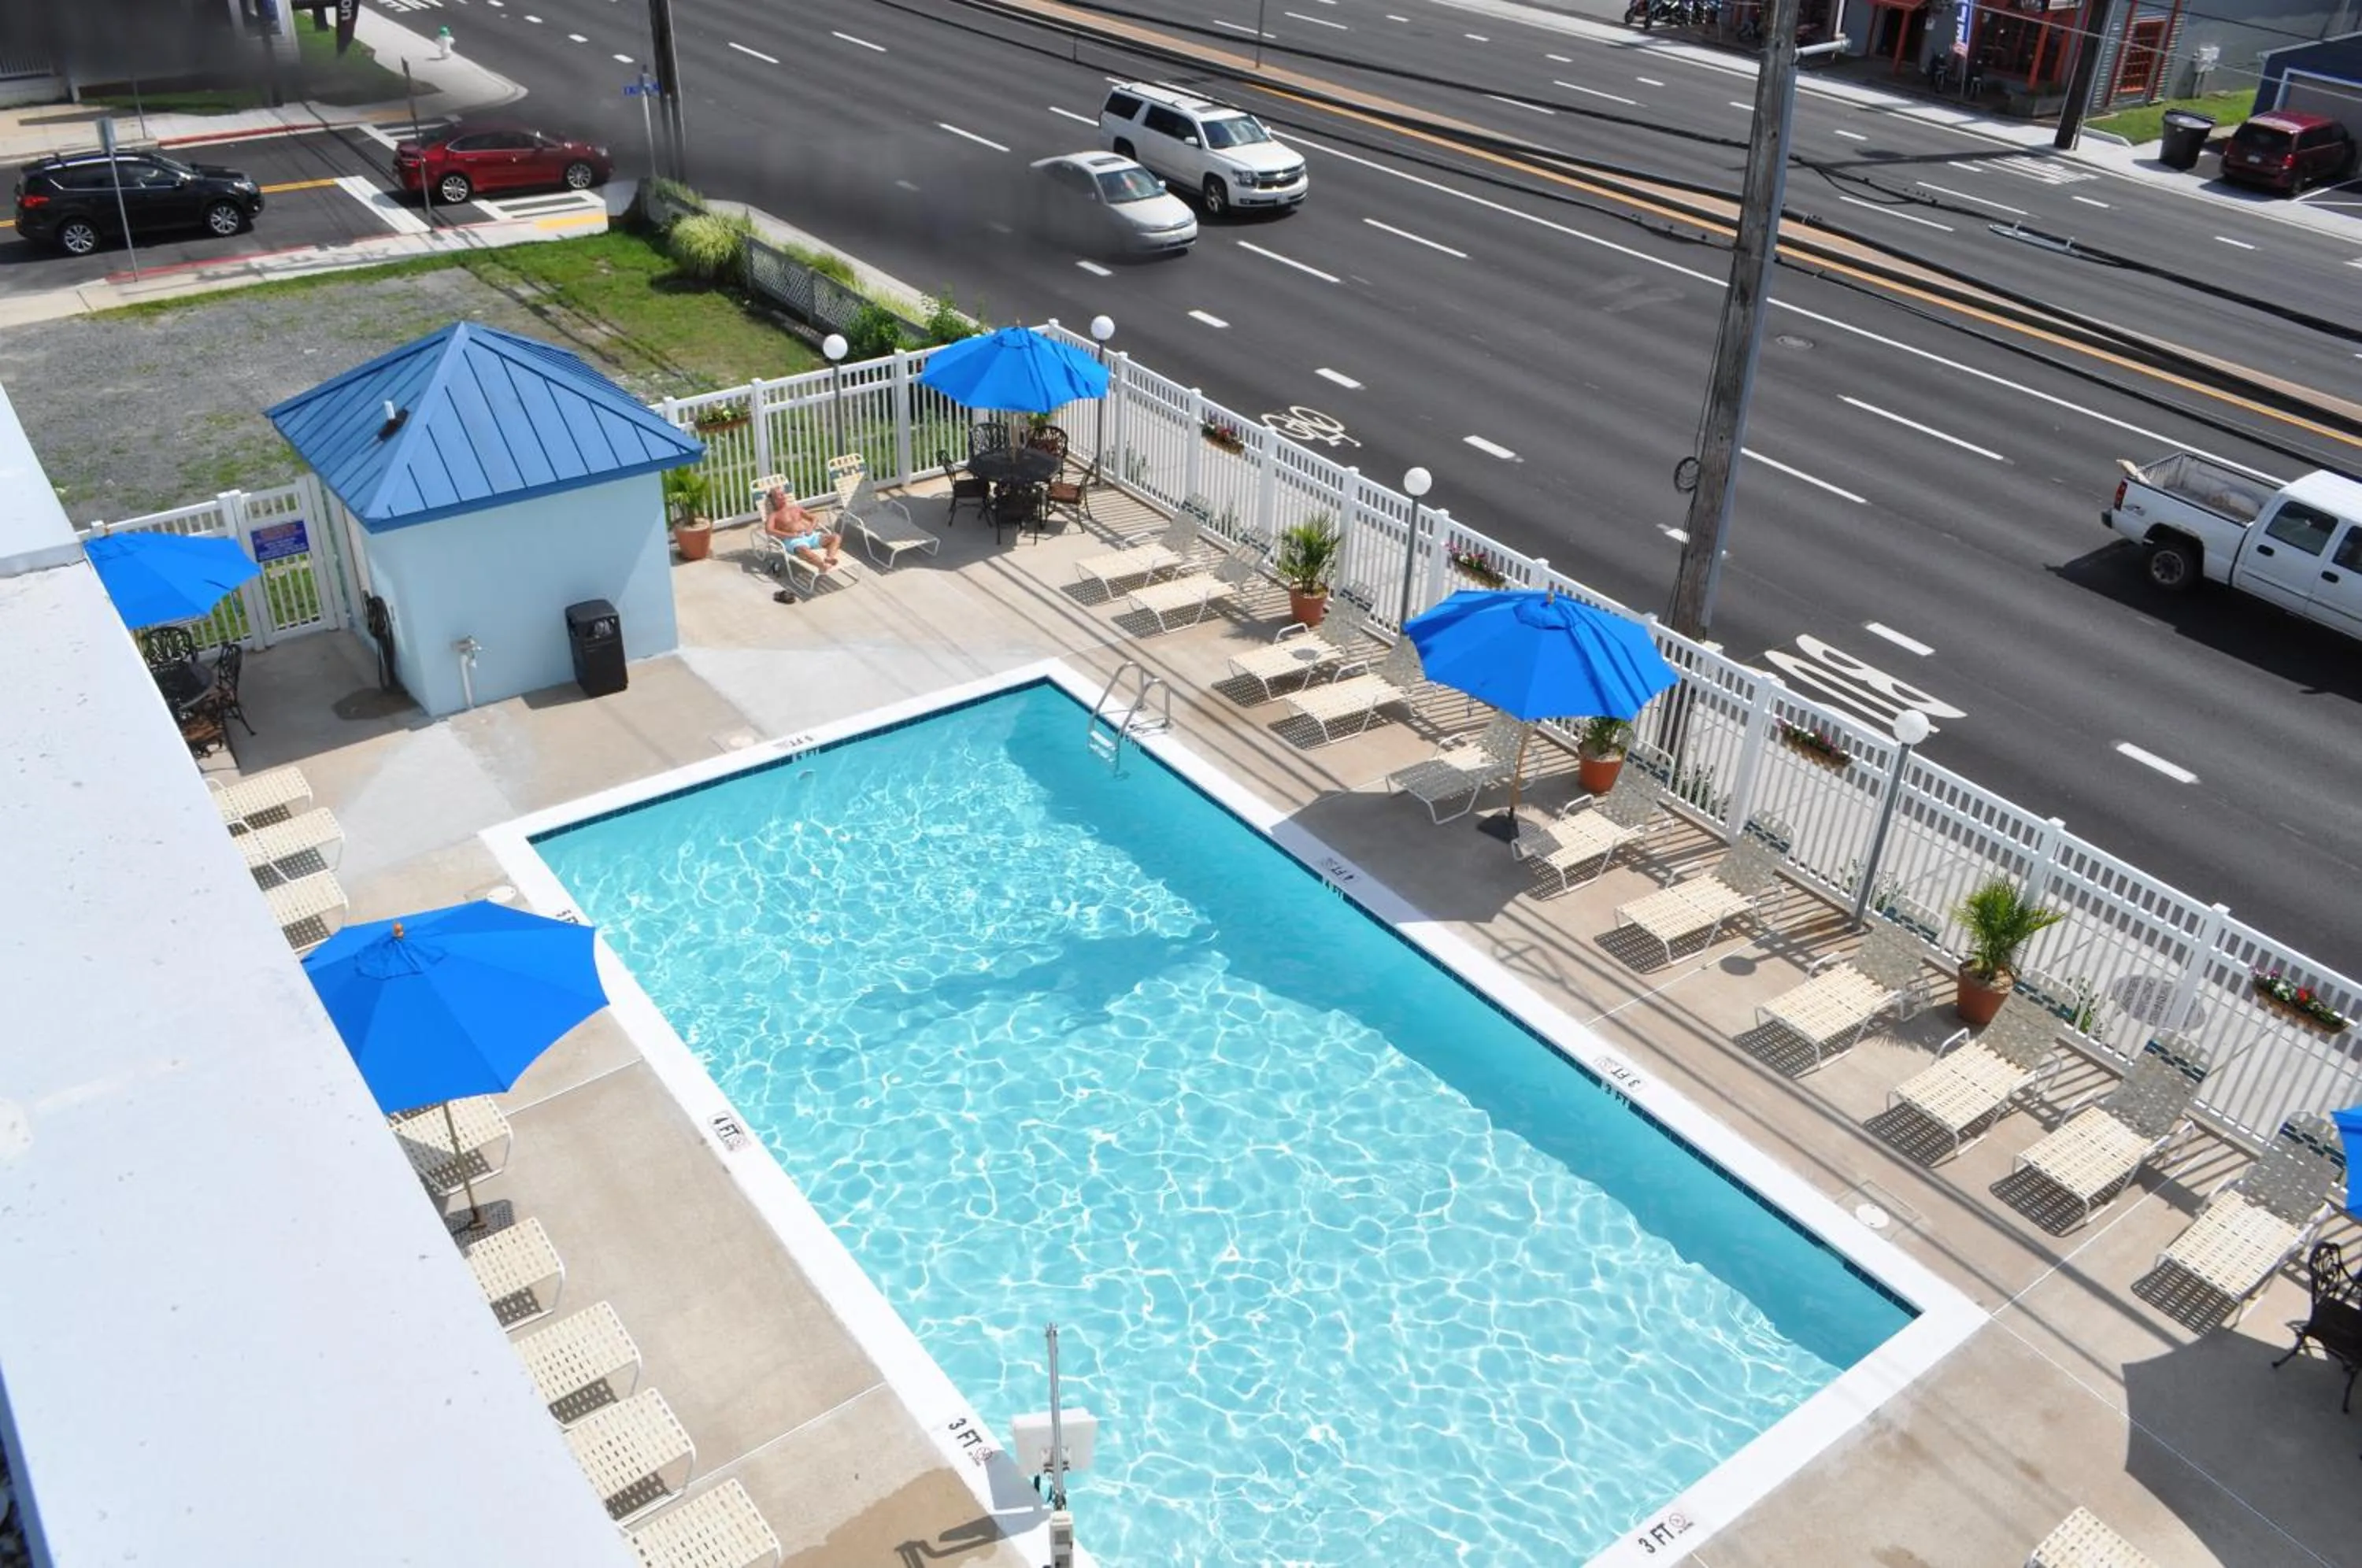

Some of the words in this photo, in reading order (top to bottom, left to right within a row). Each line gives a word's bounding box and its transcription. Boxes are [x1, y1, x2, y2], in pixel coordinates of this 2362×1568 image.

[719, 1123, 740, 1138] FT
[948, 1418, 968, 1430] 3
[957, 1429, 983, 1448] FT
[1638, 1537, 1657, 1554] 3
[1649, 1522, 1675, 1546] FT
